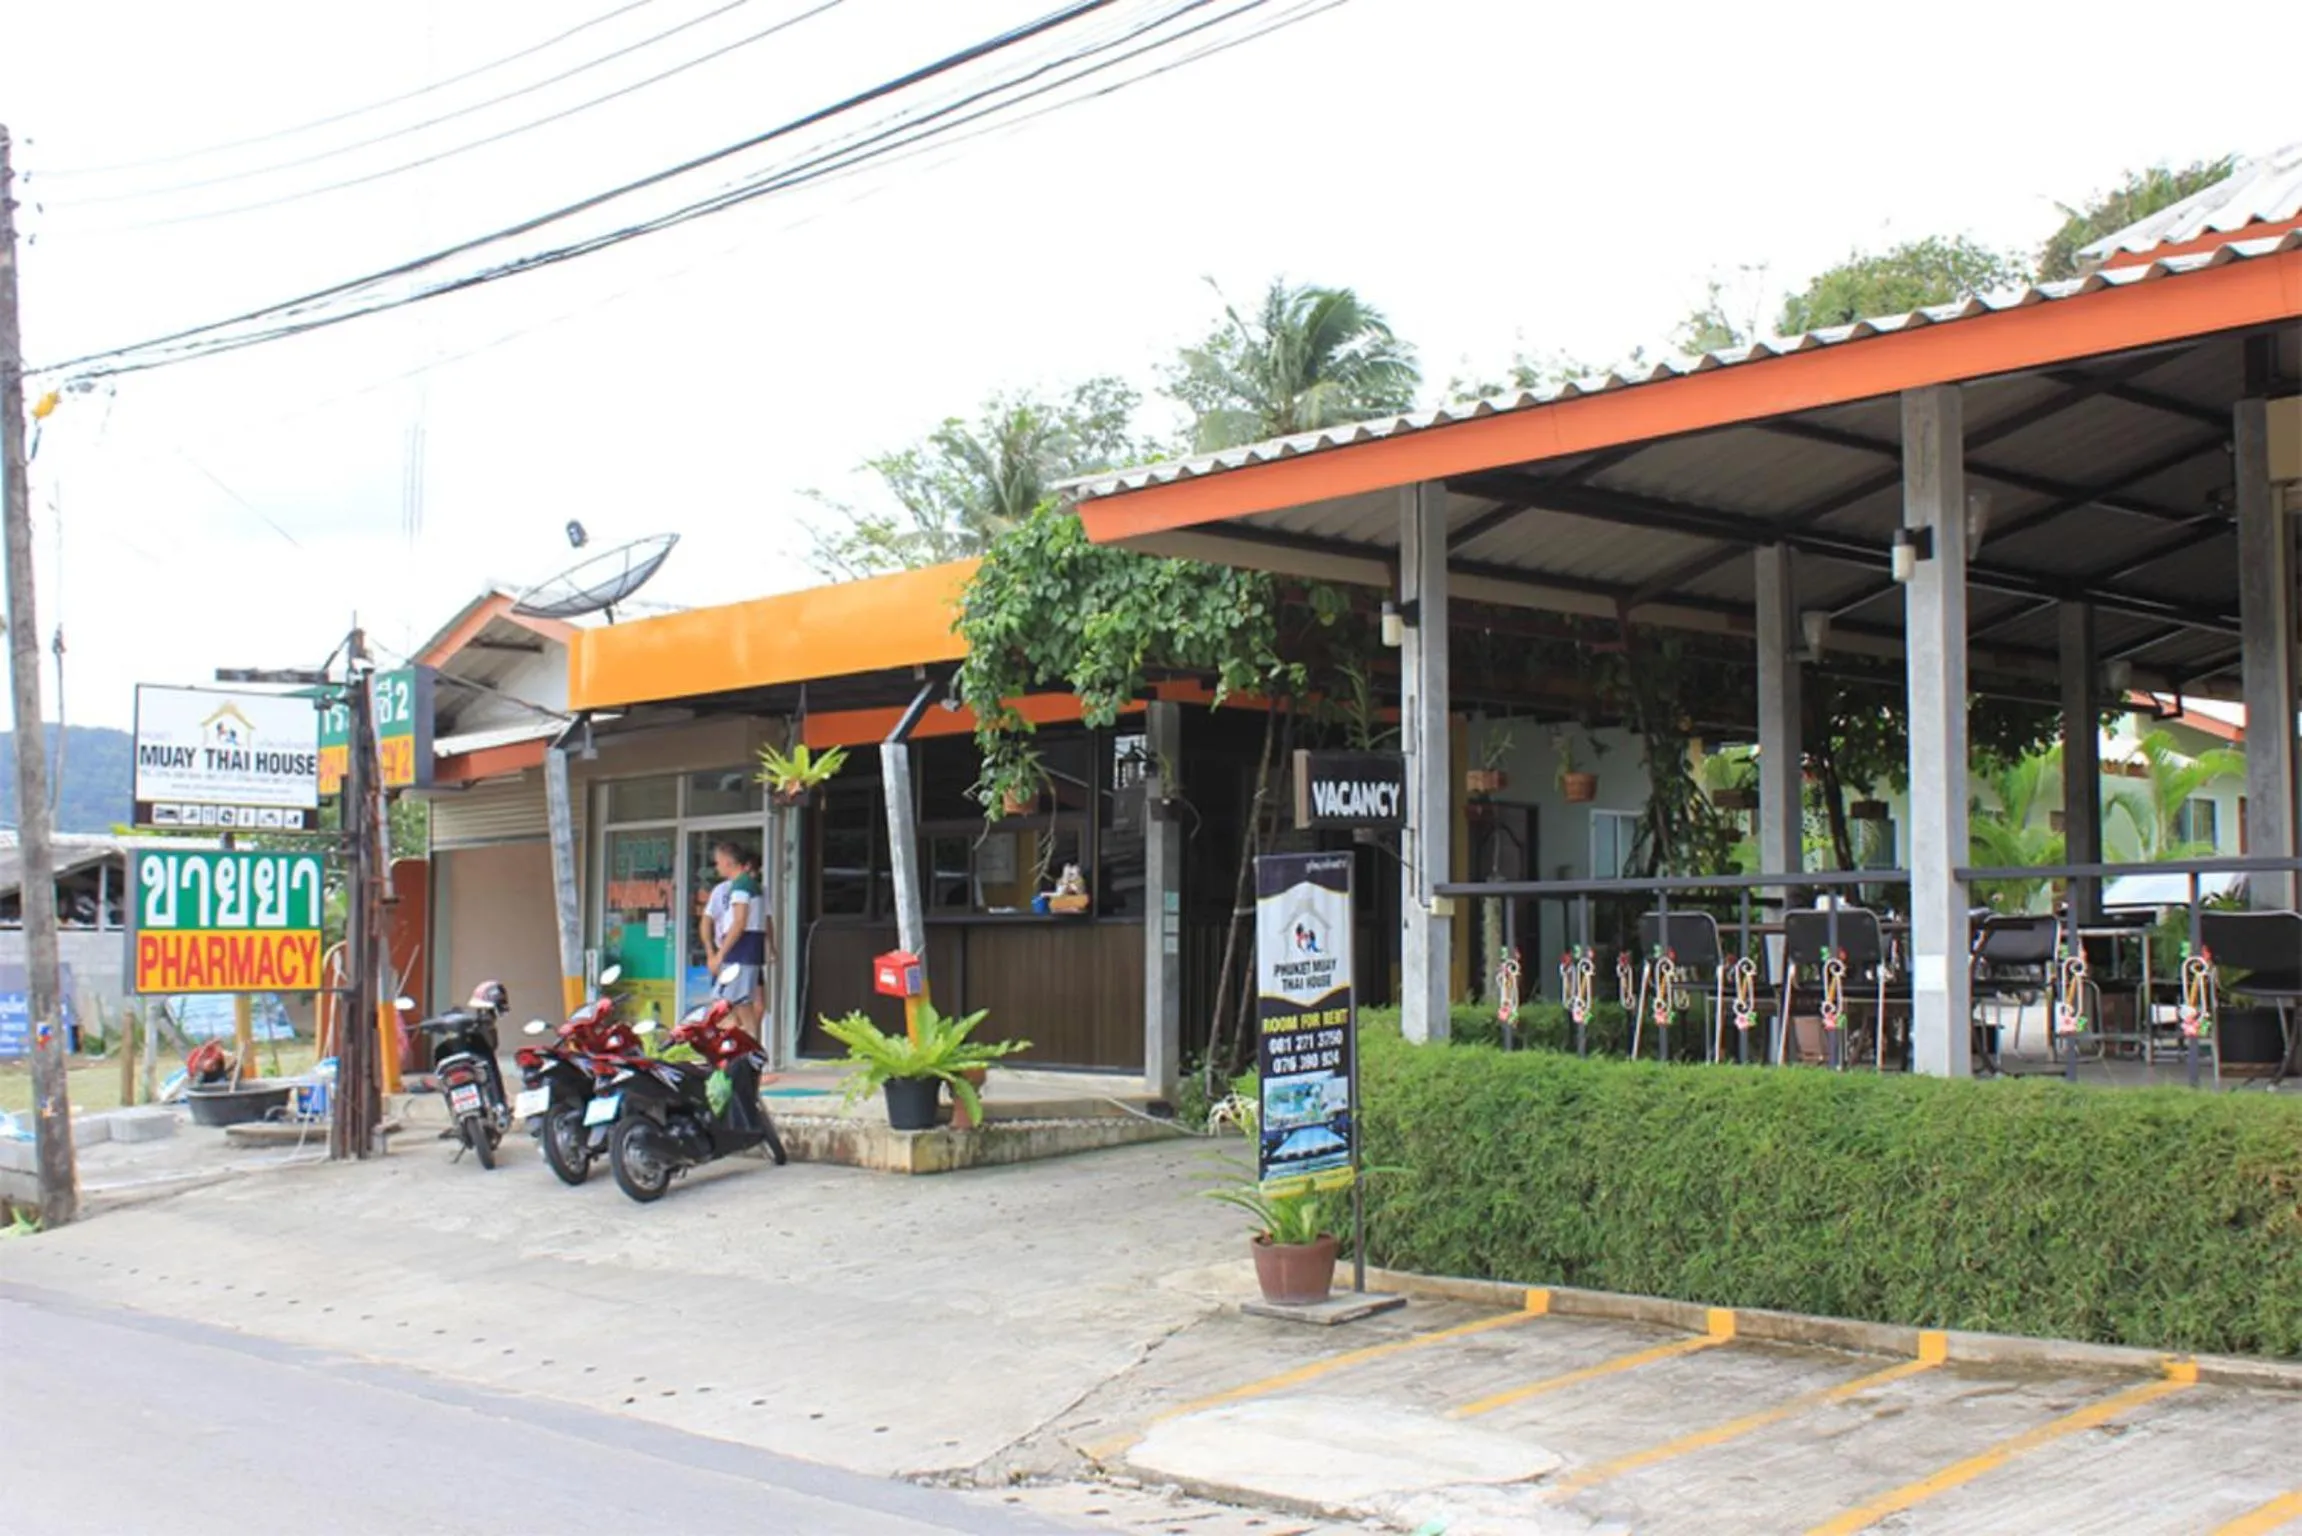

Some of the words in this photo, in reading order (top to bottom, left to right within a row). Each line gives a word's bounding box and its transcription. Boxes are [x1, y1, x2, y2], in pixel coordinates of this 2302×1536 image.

[140, 745, 196, 768] MUAY
[205, 748, 250, 771] THAI
[256, 752, 316, 776] HOUSE
[1312, 781, 1400, 817] VACANCY
[141, 855, 319, 927] ขายยา
[139, 935, 319, 988] PHARMACY
[1273, 961, 1310, 978] PHUKET
[1312, 958, 1337, 972] MUAY
[1282, 978, 1304, 992] THAI
[1262, 1015, 1298, 1034] ROOM
[1322, 1008, 1349, 1025] RENT
